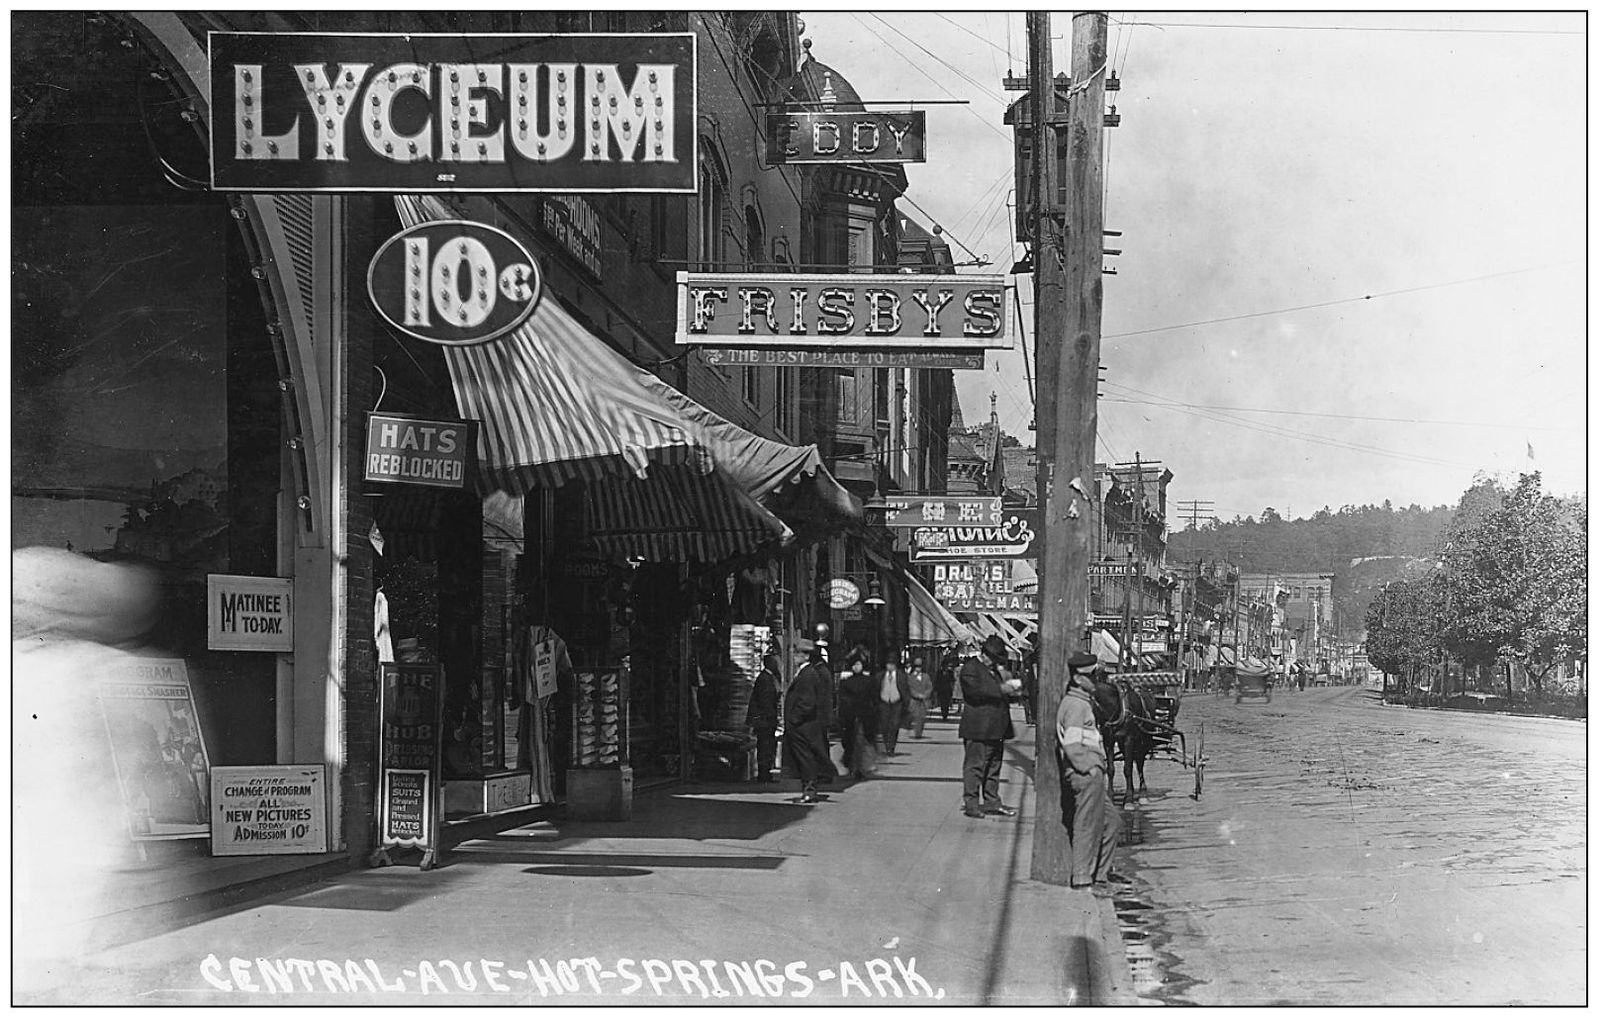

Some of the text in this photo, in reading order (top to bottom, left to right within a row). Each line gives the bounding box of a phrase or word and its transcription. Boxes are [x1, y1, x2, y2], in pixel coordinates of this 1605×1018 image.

[233, 62, 679, 163] LYCEUM
[690, 287, 1001, 337] FRISBYS
[728, 350, 759, 363] THE
[766, 350, 808, 364] BEST
[812, 351, 860, 365] PLACE
[865, 352, 883, 364] TO
[380, 423, 457, 454] HATS
[369, 453, 463, 482] REBLOCKED
[221, 593, 281, 632] MATINEE
[386, 672, 433, 690] THE
[147, 687, 187, 698] SMASHER
[385, 722, 431, 740] HUB
[249, 778, 286, 786] ENTIRE
[225, 786, 264, 798] CHANGE
[270, 785, 312, 796] PROGRAM
[392, 788, 422, 798] SUITS
[258, 799, 281, 809] ALL
[226, 808, 312, 823] NEW PICTURES
[234, 825, 287, 841] ADMISSION
[391, 821, 420, 830] HATS
